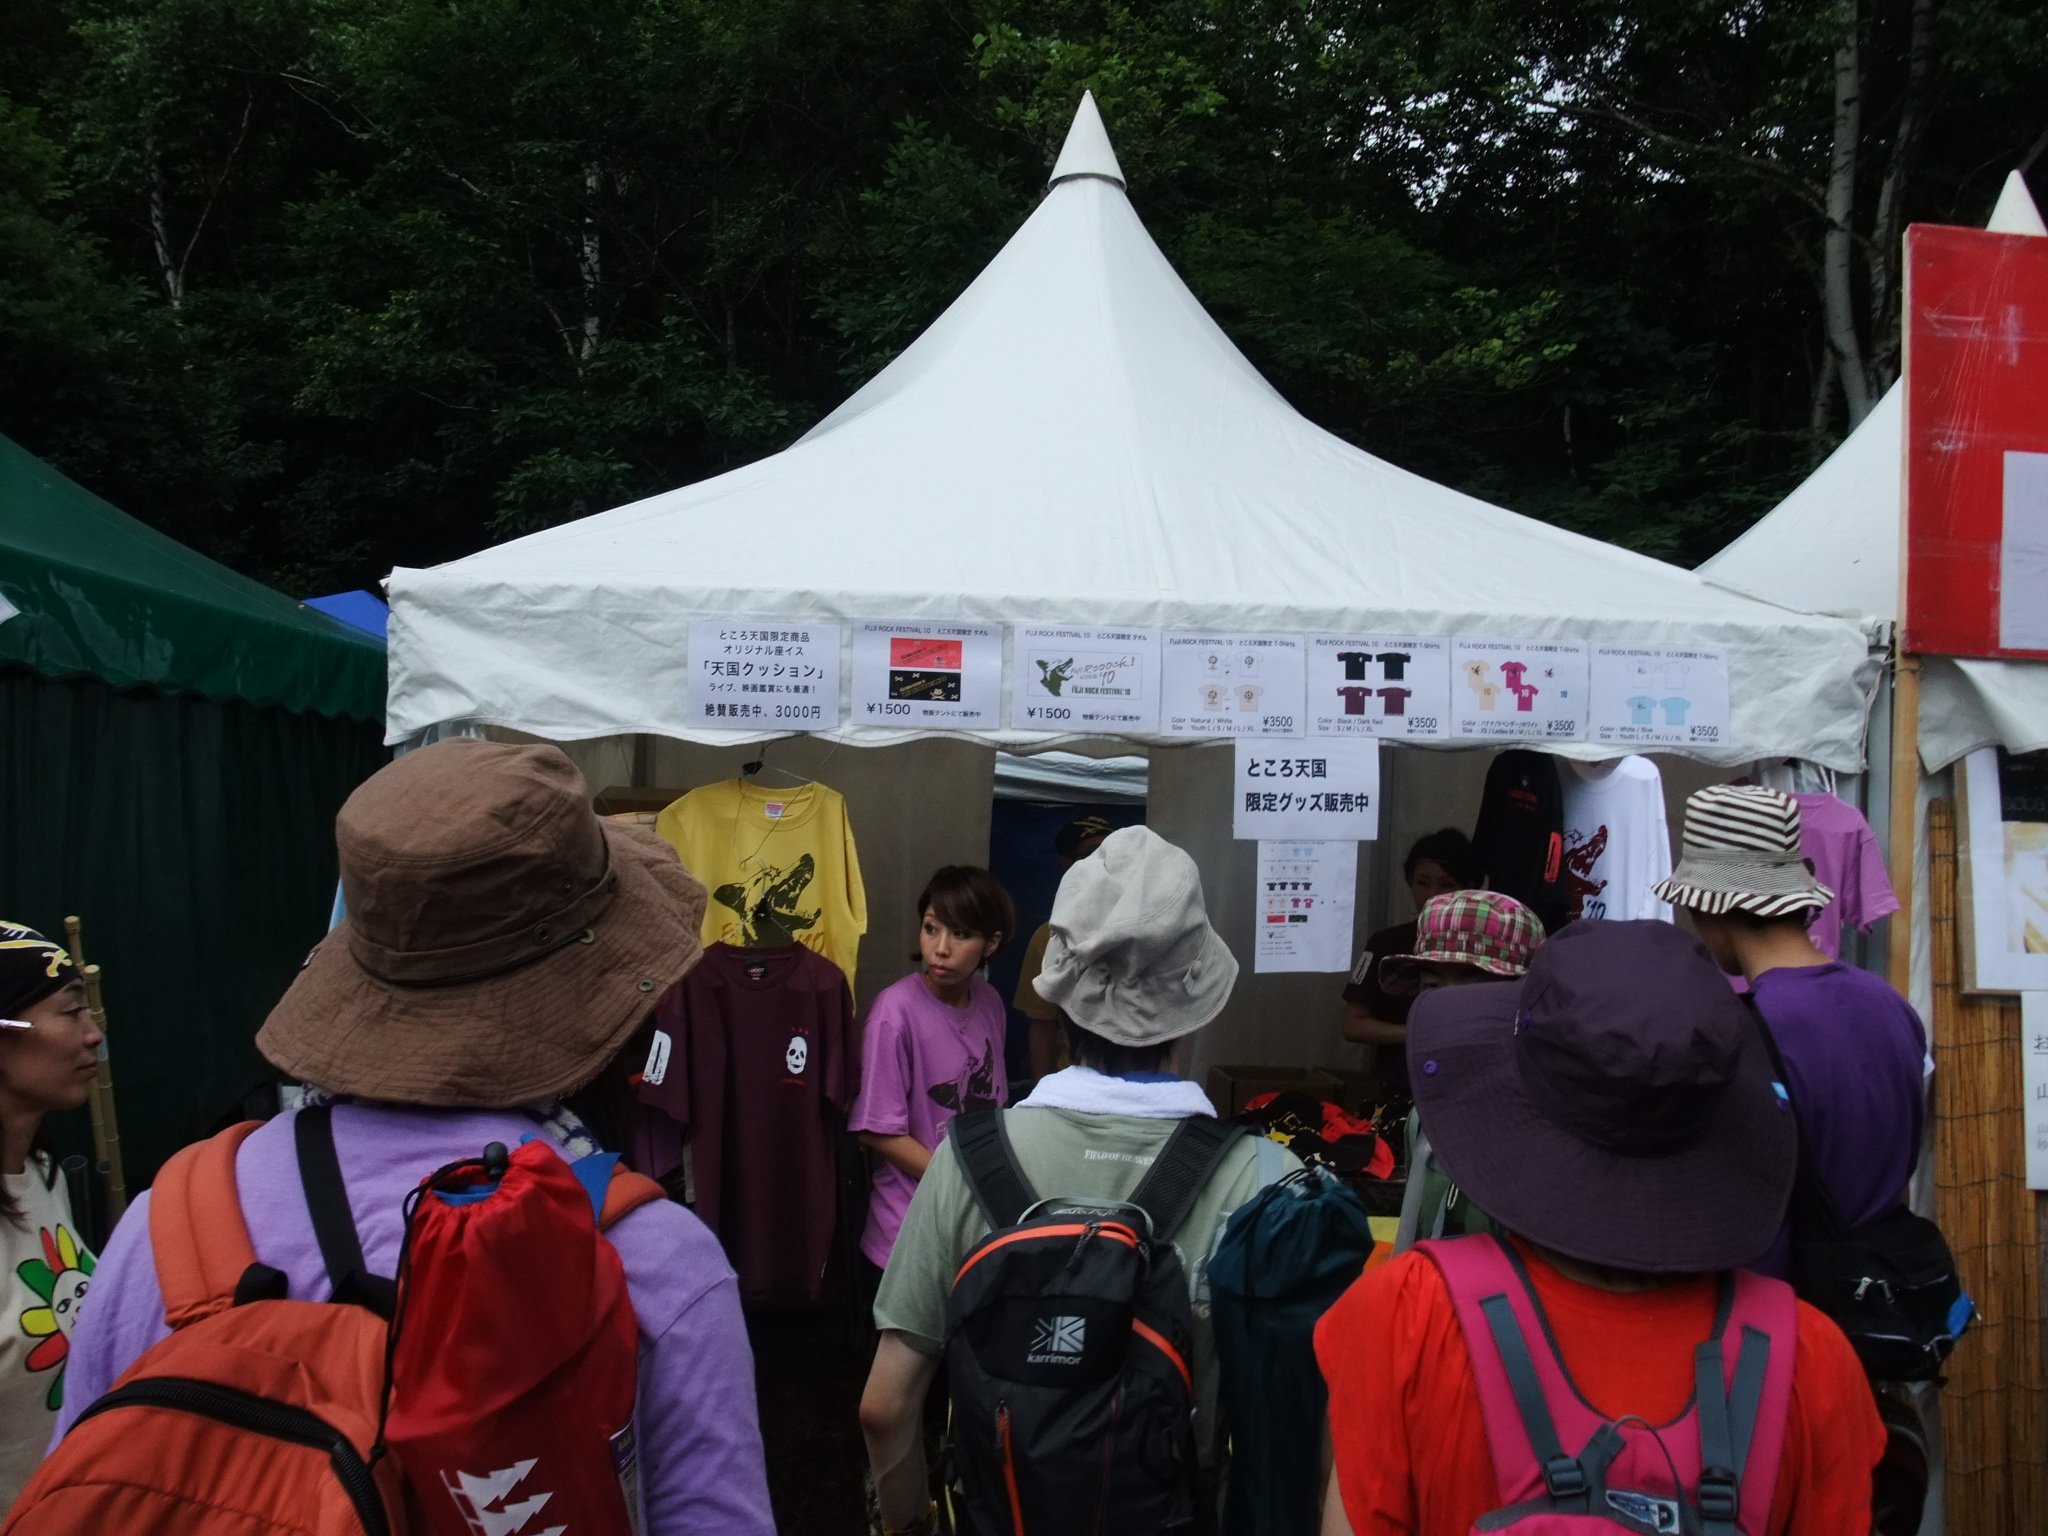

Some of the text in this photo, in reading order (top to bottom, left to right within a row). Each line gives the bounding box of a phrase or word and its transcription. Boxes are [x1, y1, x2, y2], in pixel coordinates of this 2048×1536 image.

[720, 630, 810, 643] ところ天国限定商品
[723, 644, 805, 657] オリジナル座イス
[703, 660, 824, 680] 「天国クッション」
[704, 703, 822, 719] 絶賛販売中、3000円
[867, 703, 911, 715] ¥1500
[1027, 707, 1071, 720] ¥1500
[1262, 716, 1293, 727] ¥3500
[1407, 717, 1437, 729] ¥3500
[1546, 719, 1575, 731] ¥3500
[1690, 725, 1719, 737] ¥3500
[1247, 757, 1327, 779] ところ天国
[1244, 791, 1370, 813] 限定グッズ販売中
[1026, 1353, 1083, 1365] karrimor
